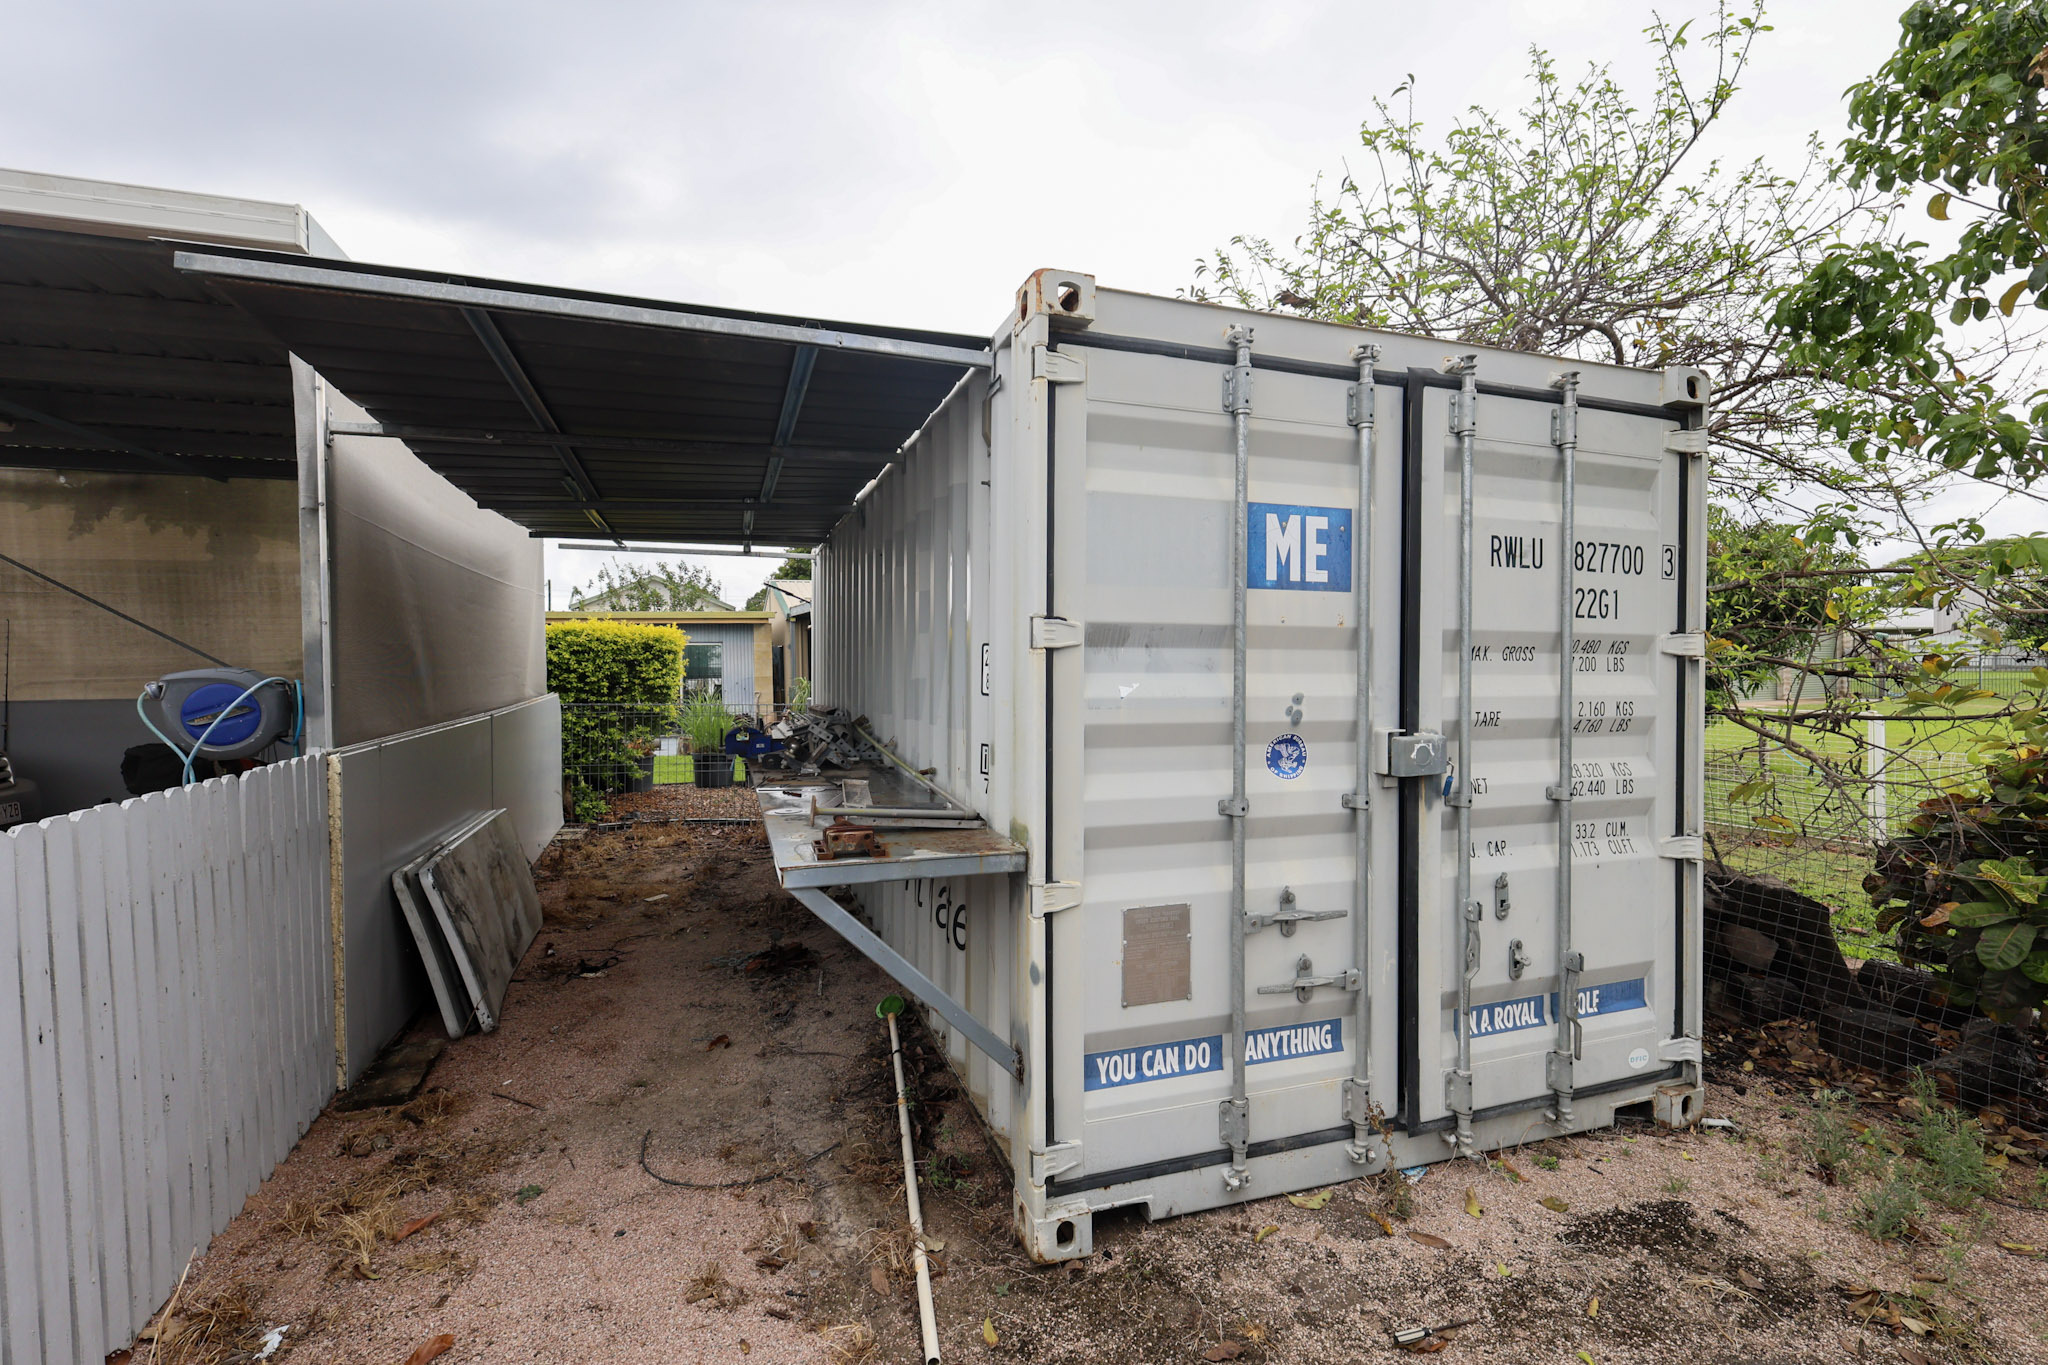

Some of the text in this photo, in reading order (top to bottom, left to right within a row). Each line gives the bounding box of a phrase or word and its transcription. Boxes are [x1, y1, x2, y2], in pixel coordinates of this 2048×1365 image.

[1265, 512, 1329, 583] ME
[1490, 534, 1675, 577] RWLU 827700 3
[1574, 587, 1619, 620] 22G1
[1501, 645, 1536, 662] GROSS
[1571, 639, 1630, 655] 0.480 KGS
[1606, 657, 1625, 672] LBS
[1578, 701, 1634, 717] 2.160 KGS
[1474, 711, 1502, 728] TARE
[1573, 718, 1632, 734] 4.760 LBS
[1610, 762, 1633, 777] KGS
[1572, 779, 1634, 797] 62.440 LBS
[1575, 823, 1596, 840] 33.2
[1480, 1008, 1493, 1034] A
[1494, 1000, 1540, 1031] ROYAL
[1577, 989, 1600, 1015] OLF
[1096, 1023, 1333, 1085] YOU CAN DO ANYTHING
